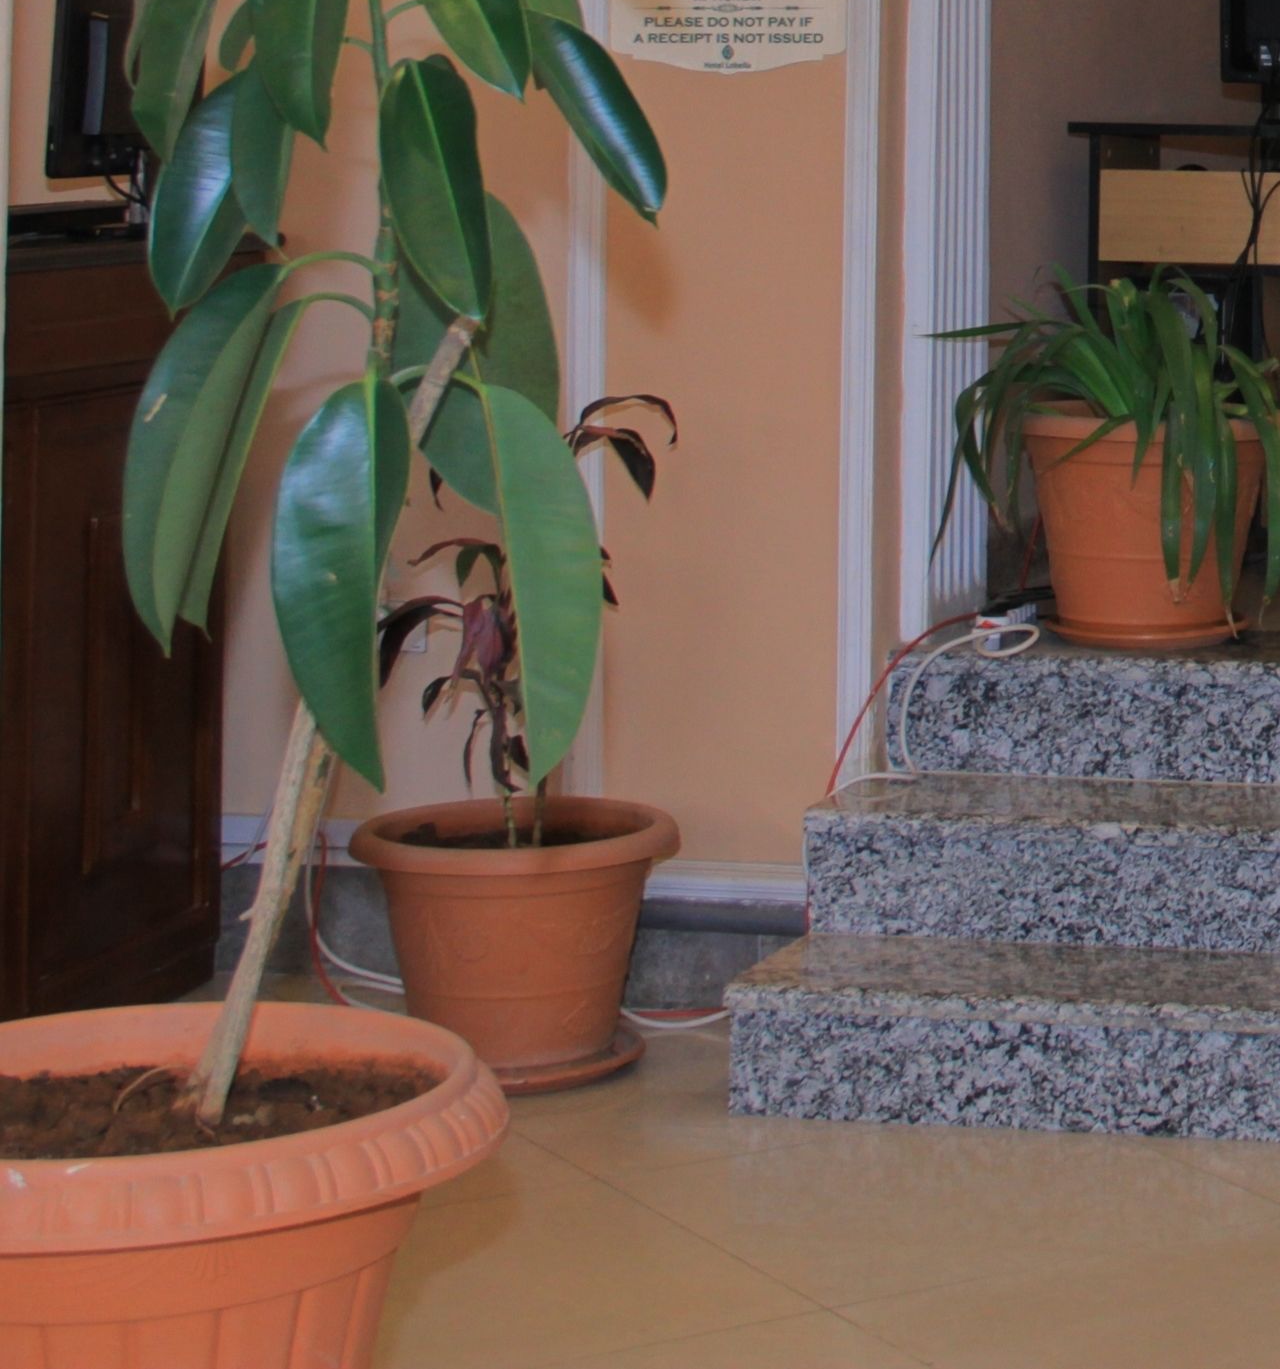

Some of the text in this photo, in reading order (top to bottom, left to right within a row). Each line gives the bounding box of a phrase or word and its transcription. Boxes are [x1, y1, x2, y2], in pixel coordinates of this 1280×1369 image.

[644, 17, 814, 28] PLEASE DO NOT PAY IF
[633, 33, 824, 43] A RECEIPT IS NOT ISSUED
